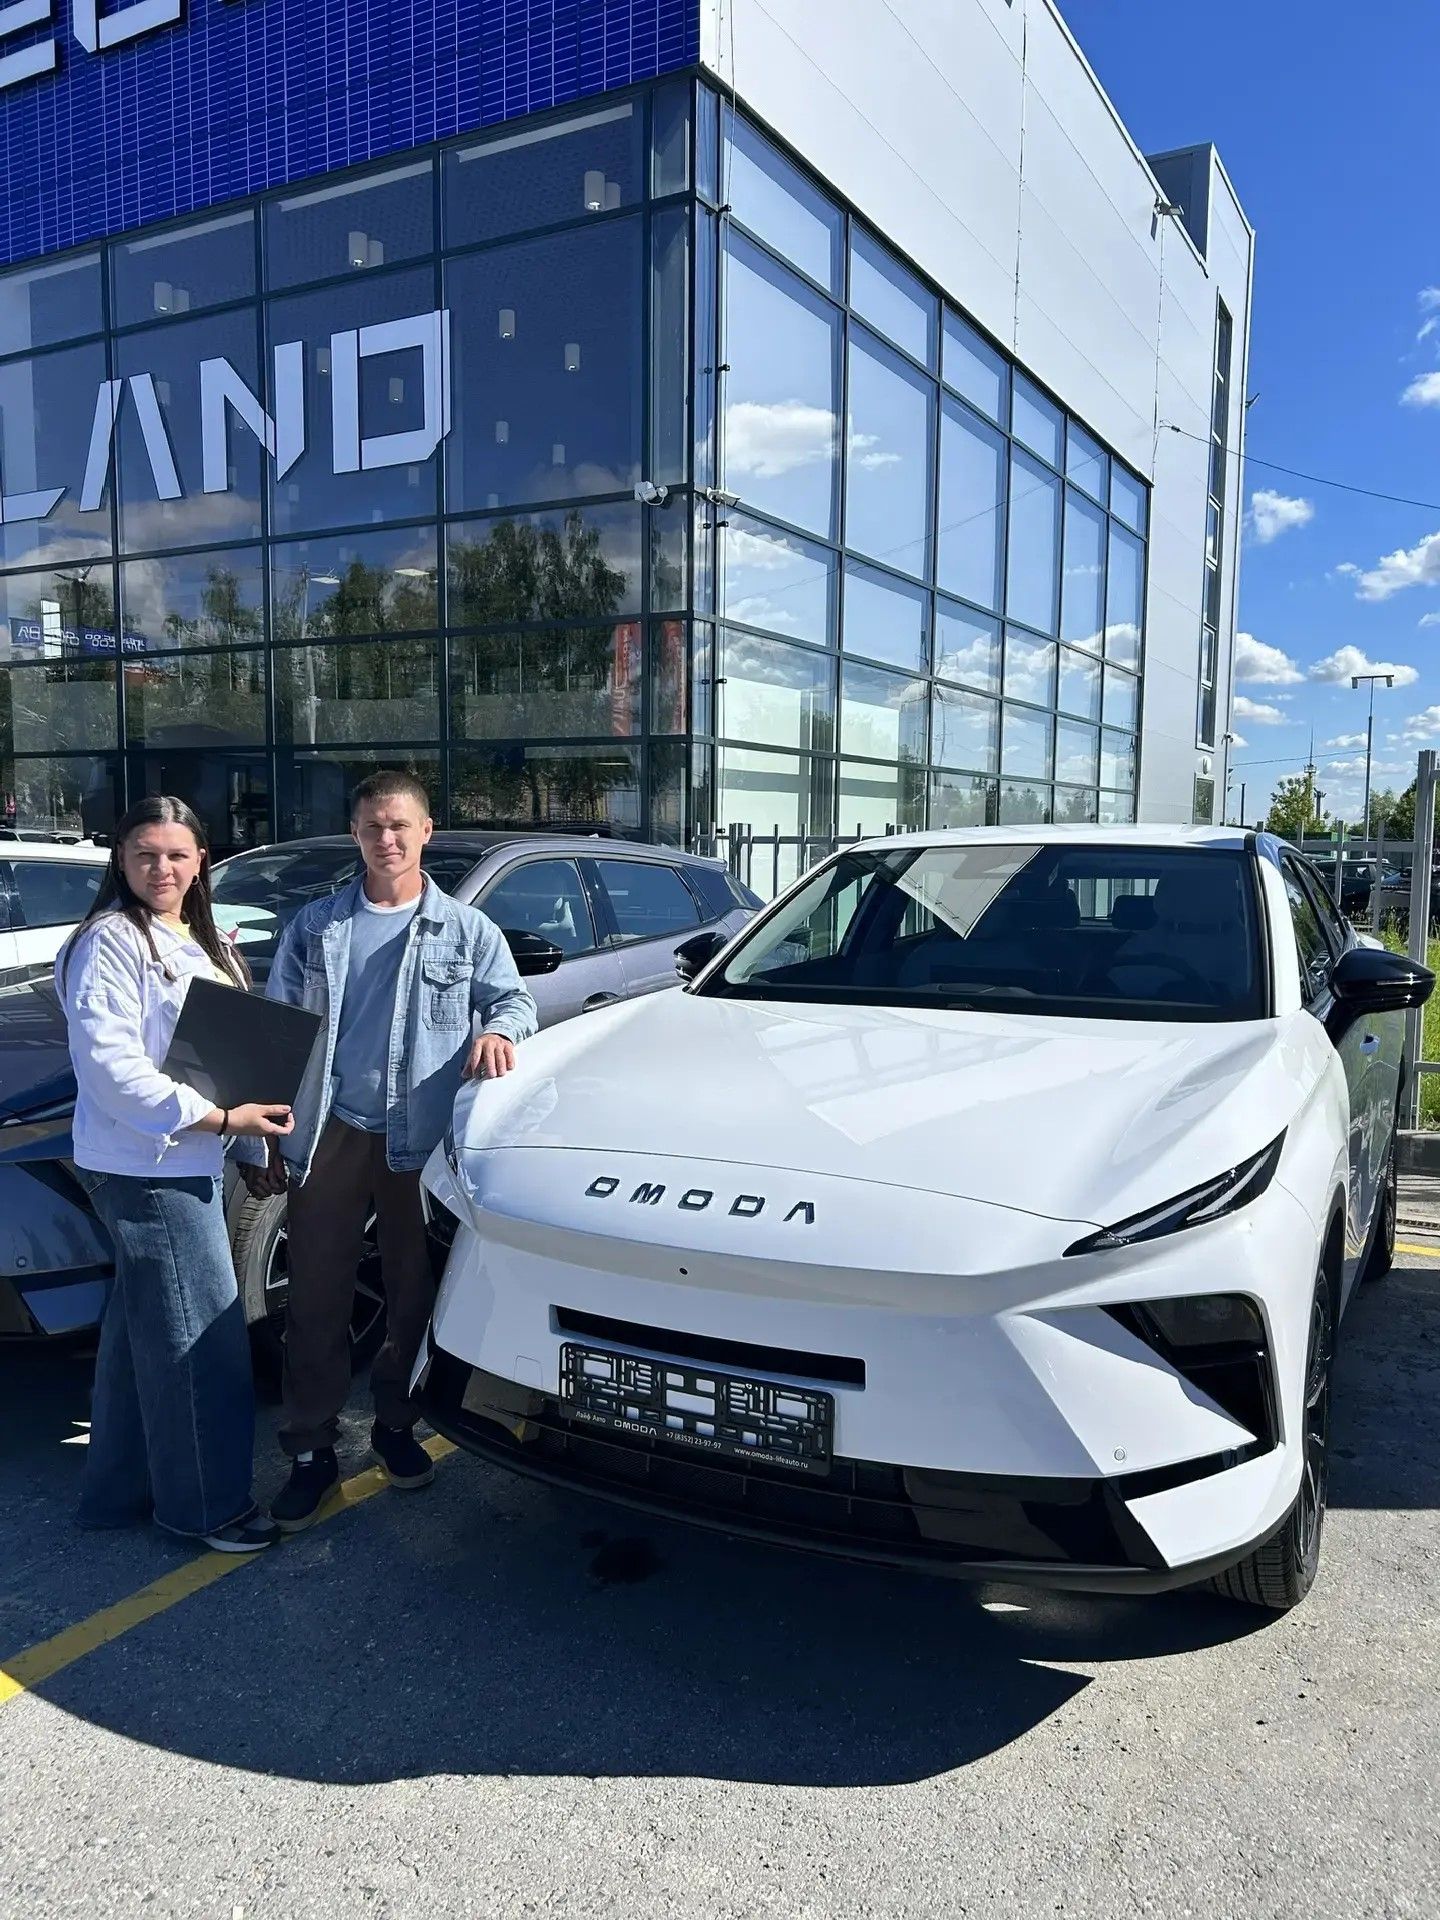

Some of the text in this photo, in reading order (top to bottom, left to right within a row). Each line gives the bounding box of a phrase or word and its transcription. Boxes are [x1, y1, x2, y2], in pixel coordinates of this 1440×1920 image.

[584, 1176, 815, 1224] OMODA
[614, 1419, 657, 1435] OMODA
[734, 1447, 808, 1468] www.omoda-lifeauto.ru
